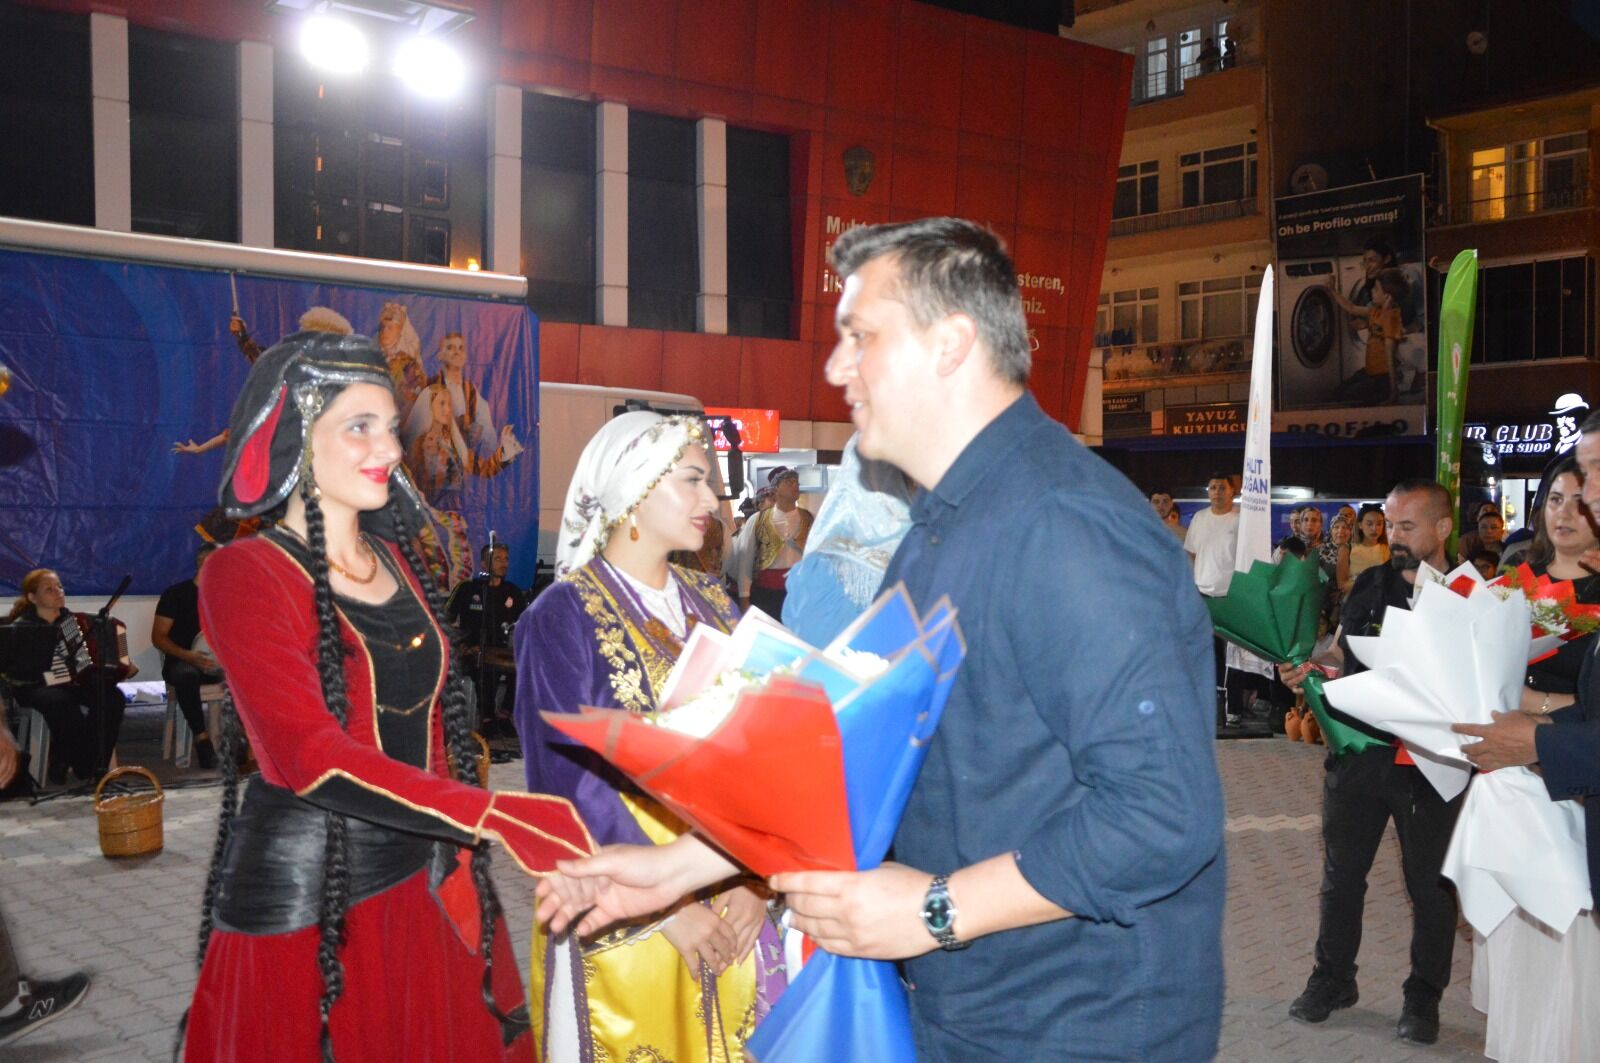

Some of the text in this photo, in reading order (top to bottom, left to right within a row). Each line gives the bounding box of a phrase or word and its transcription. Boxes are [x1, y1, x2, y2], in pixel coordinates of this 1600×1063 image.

[1278, 226, 1294, 236] Oh
[1296, 224, 1311, 233] be
[1313, 217, 1352, 231] Profilo
[1353, 208, 1399, 225] varmış!
[1185, 410, 1237, 422] YAVUZ
[1495, 423, 1554, 442] CLUB
[1516, 442, 1552, 454] SHOP
